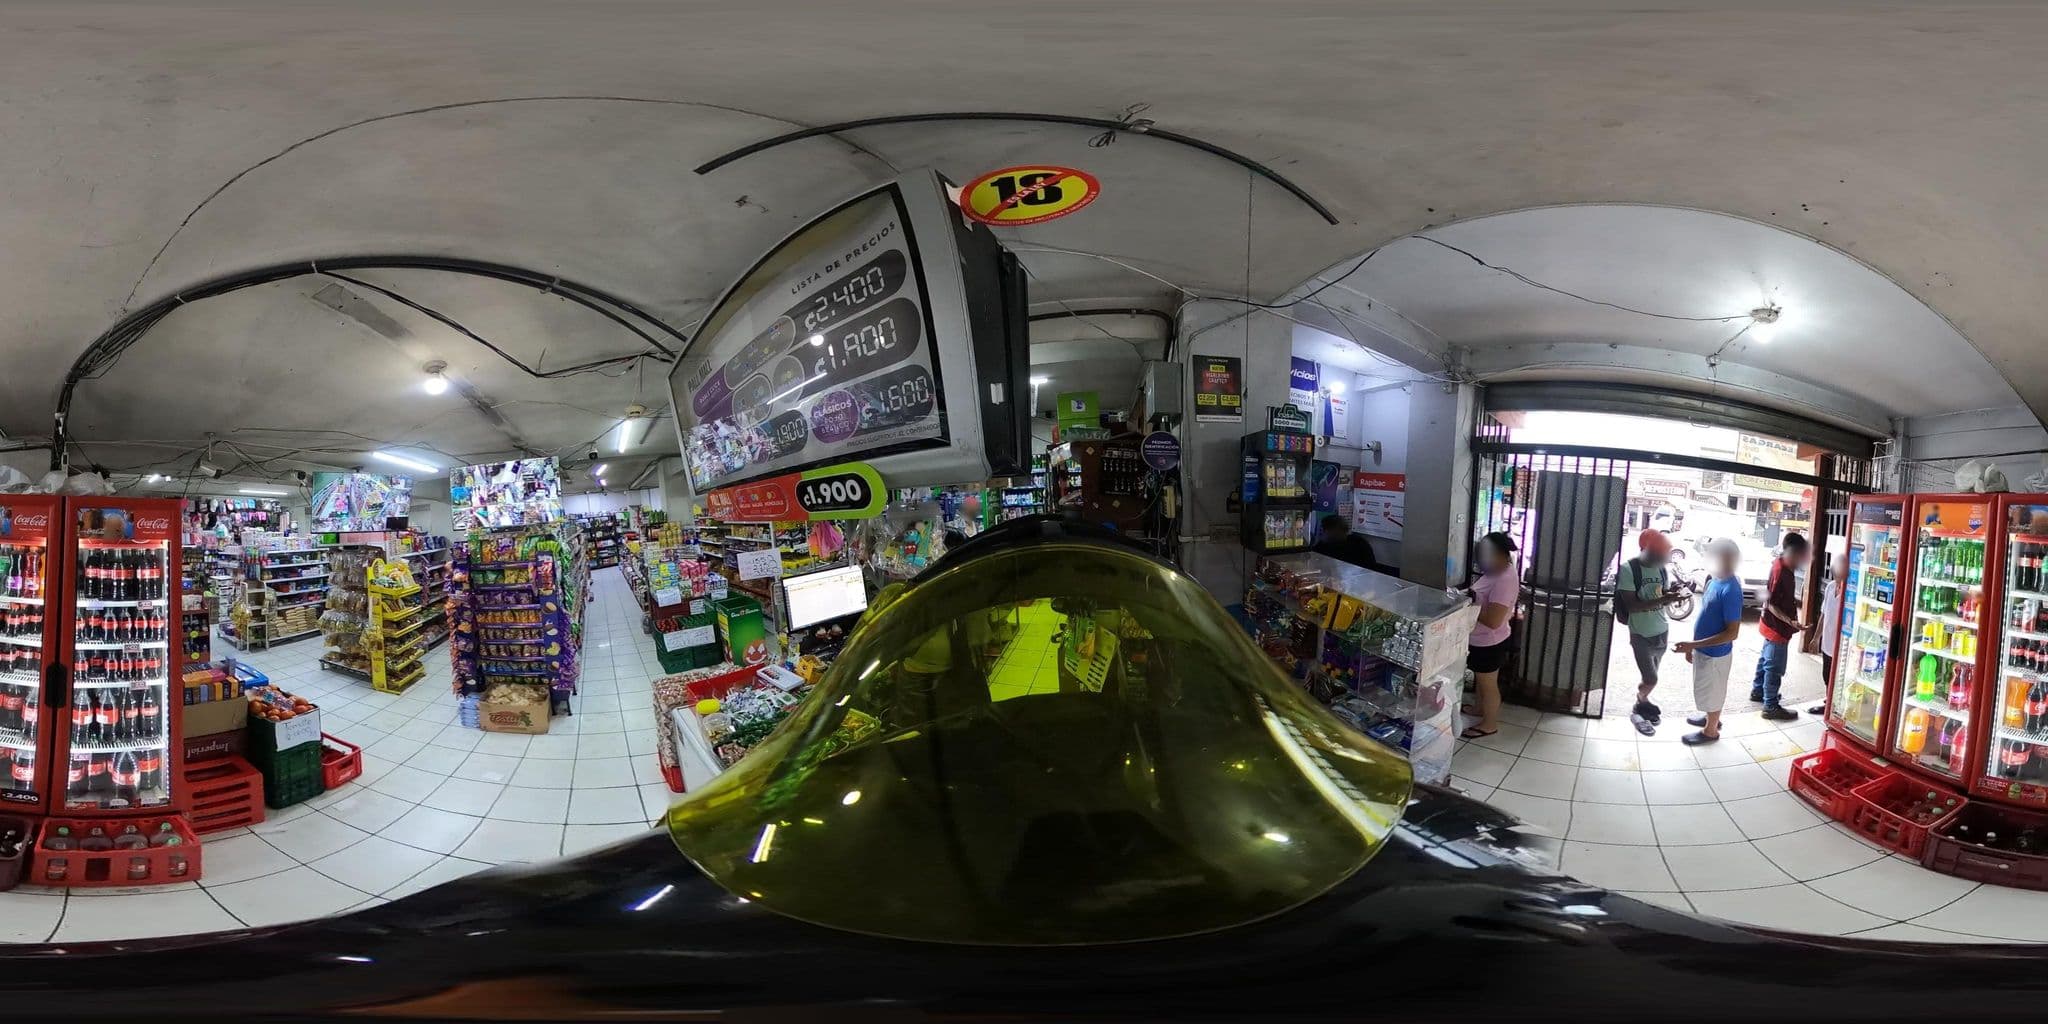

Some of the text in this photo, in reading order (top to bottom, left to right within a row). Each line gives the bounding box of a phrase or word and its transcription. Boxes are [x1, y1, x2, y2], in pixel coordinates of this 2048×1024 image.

[990, 172, 1063, 208] 18
[791, 221, 896, 295] LISTA DE PRECIOS
[803, 478, 862, 506] ¢1.900
[1360, 478, 1387, 487] Rapibac
[186, 741, 229, 759] Imperial
